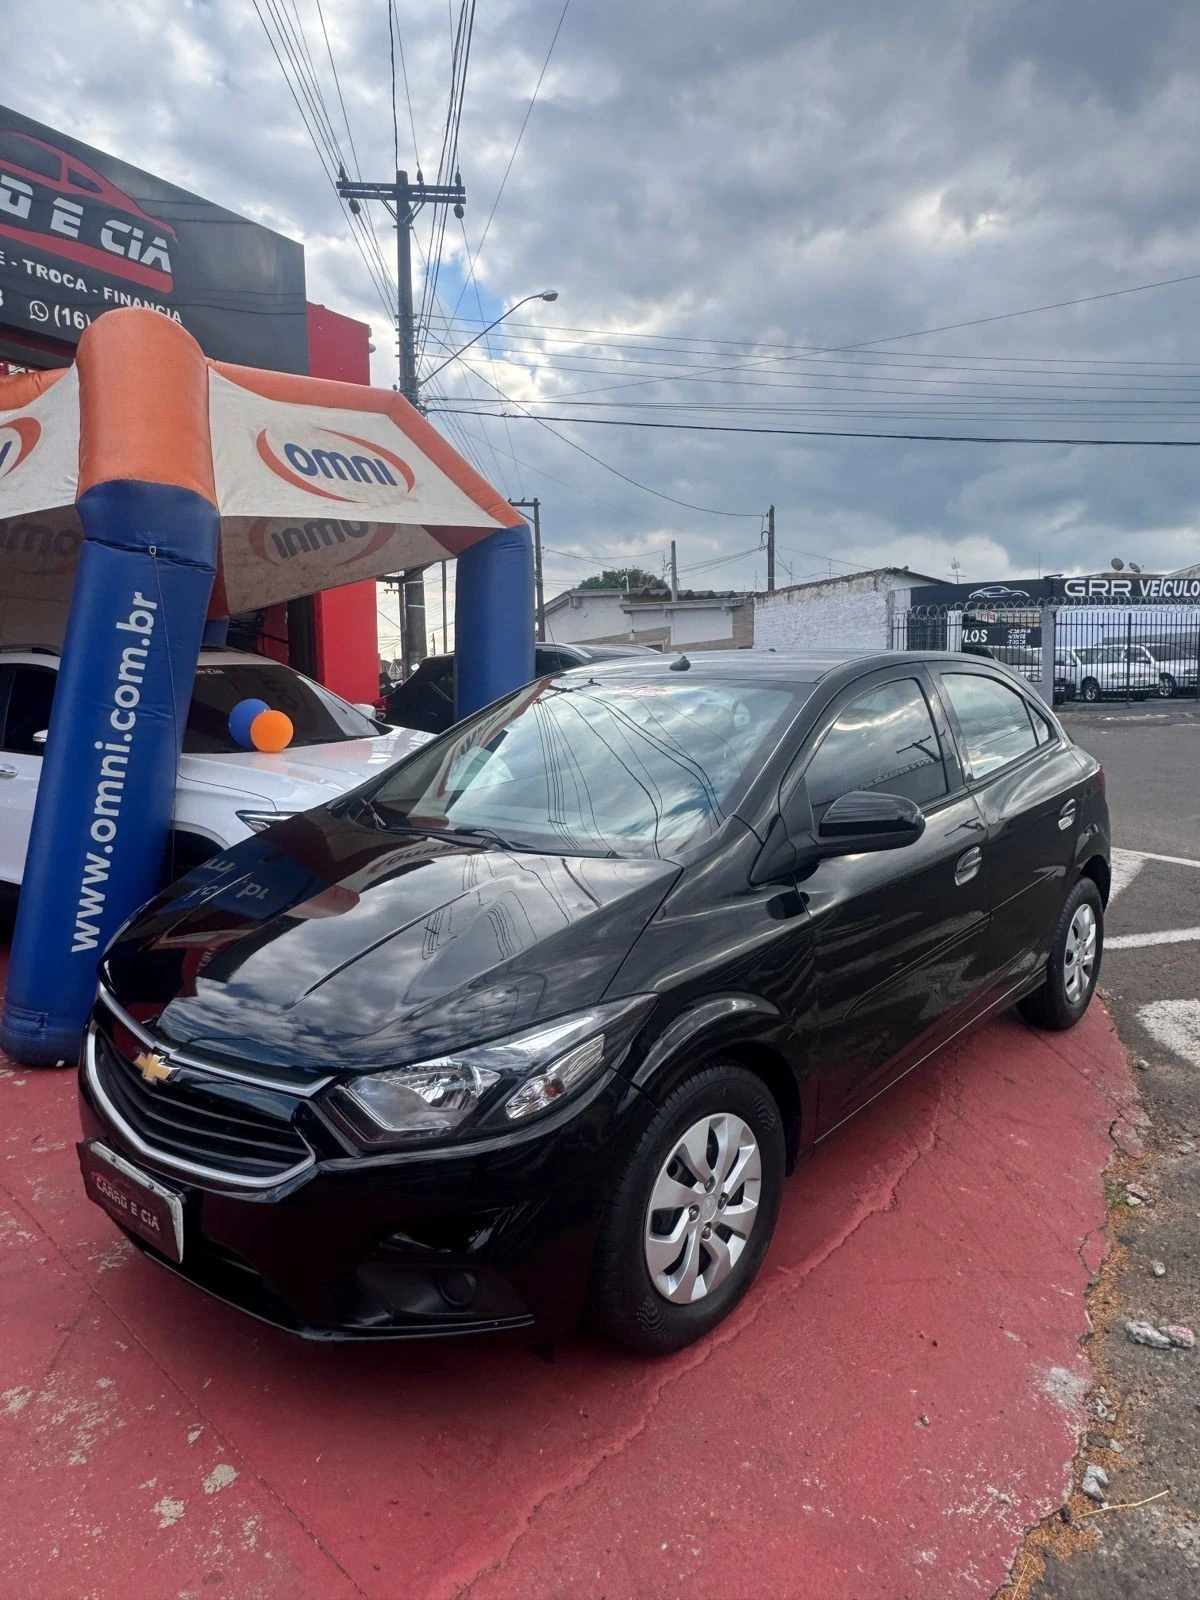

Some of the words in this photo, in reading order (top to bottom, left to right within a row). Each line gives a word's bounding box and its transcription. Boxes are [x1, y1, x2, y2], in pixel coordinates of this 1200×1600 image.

[50, 197, 83, 239] E
[22, 259, 88, 293] TROCA
[1064, 579, 1132, 597] GRR
[71, 591, 159, 953] www.omni.com.br
